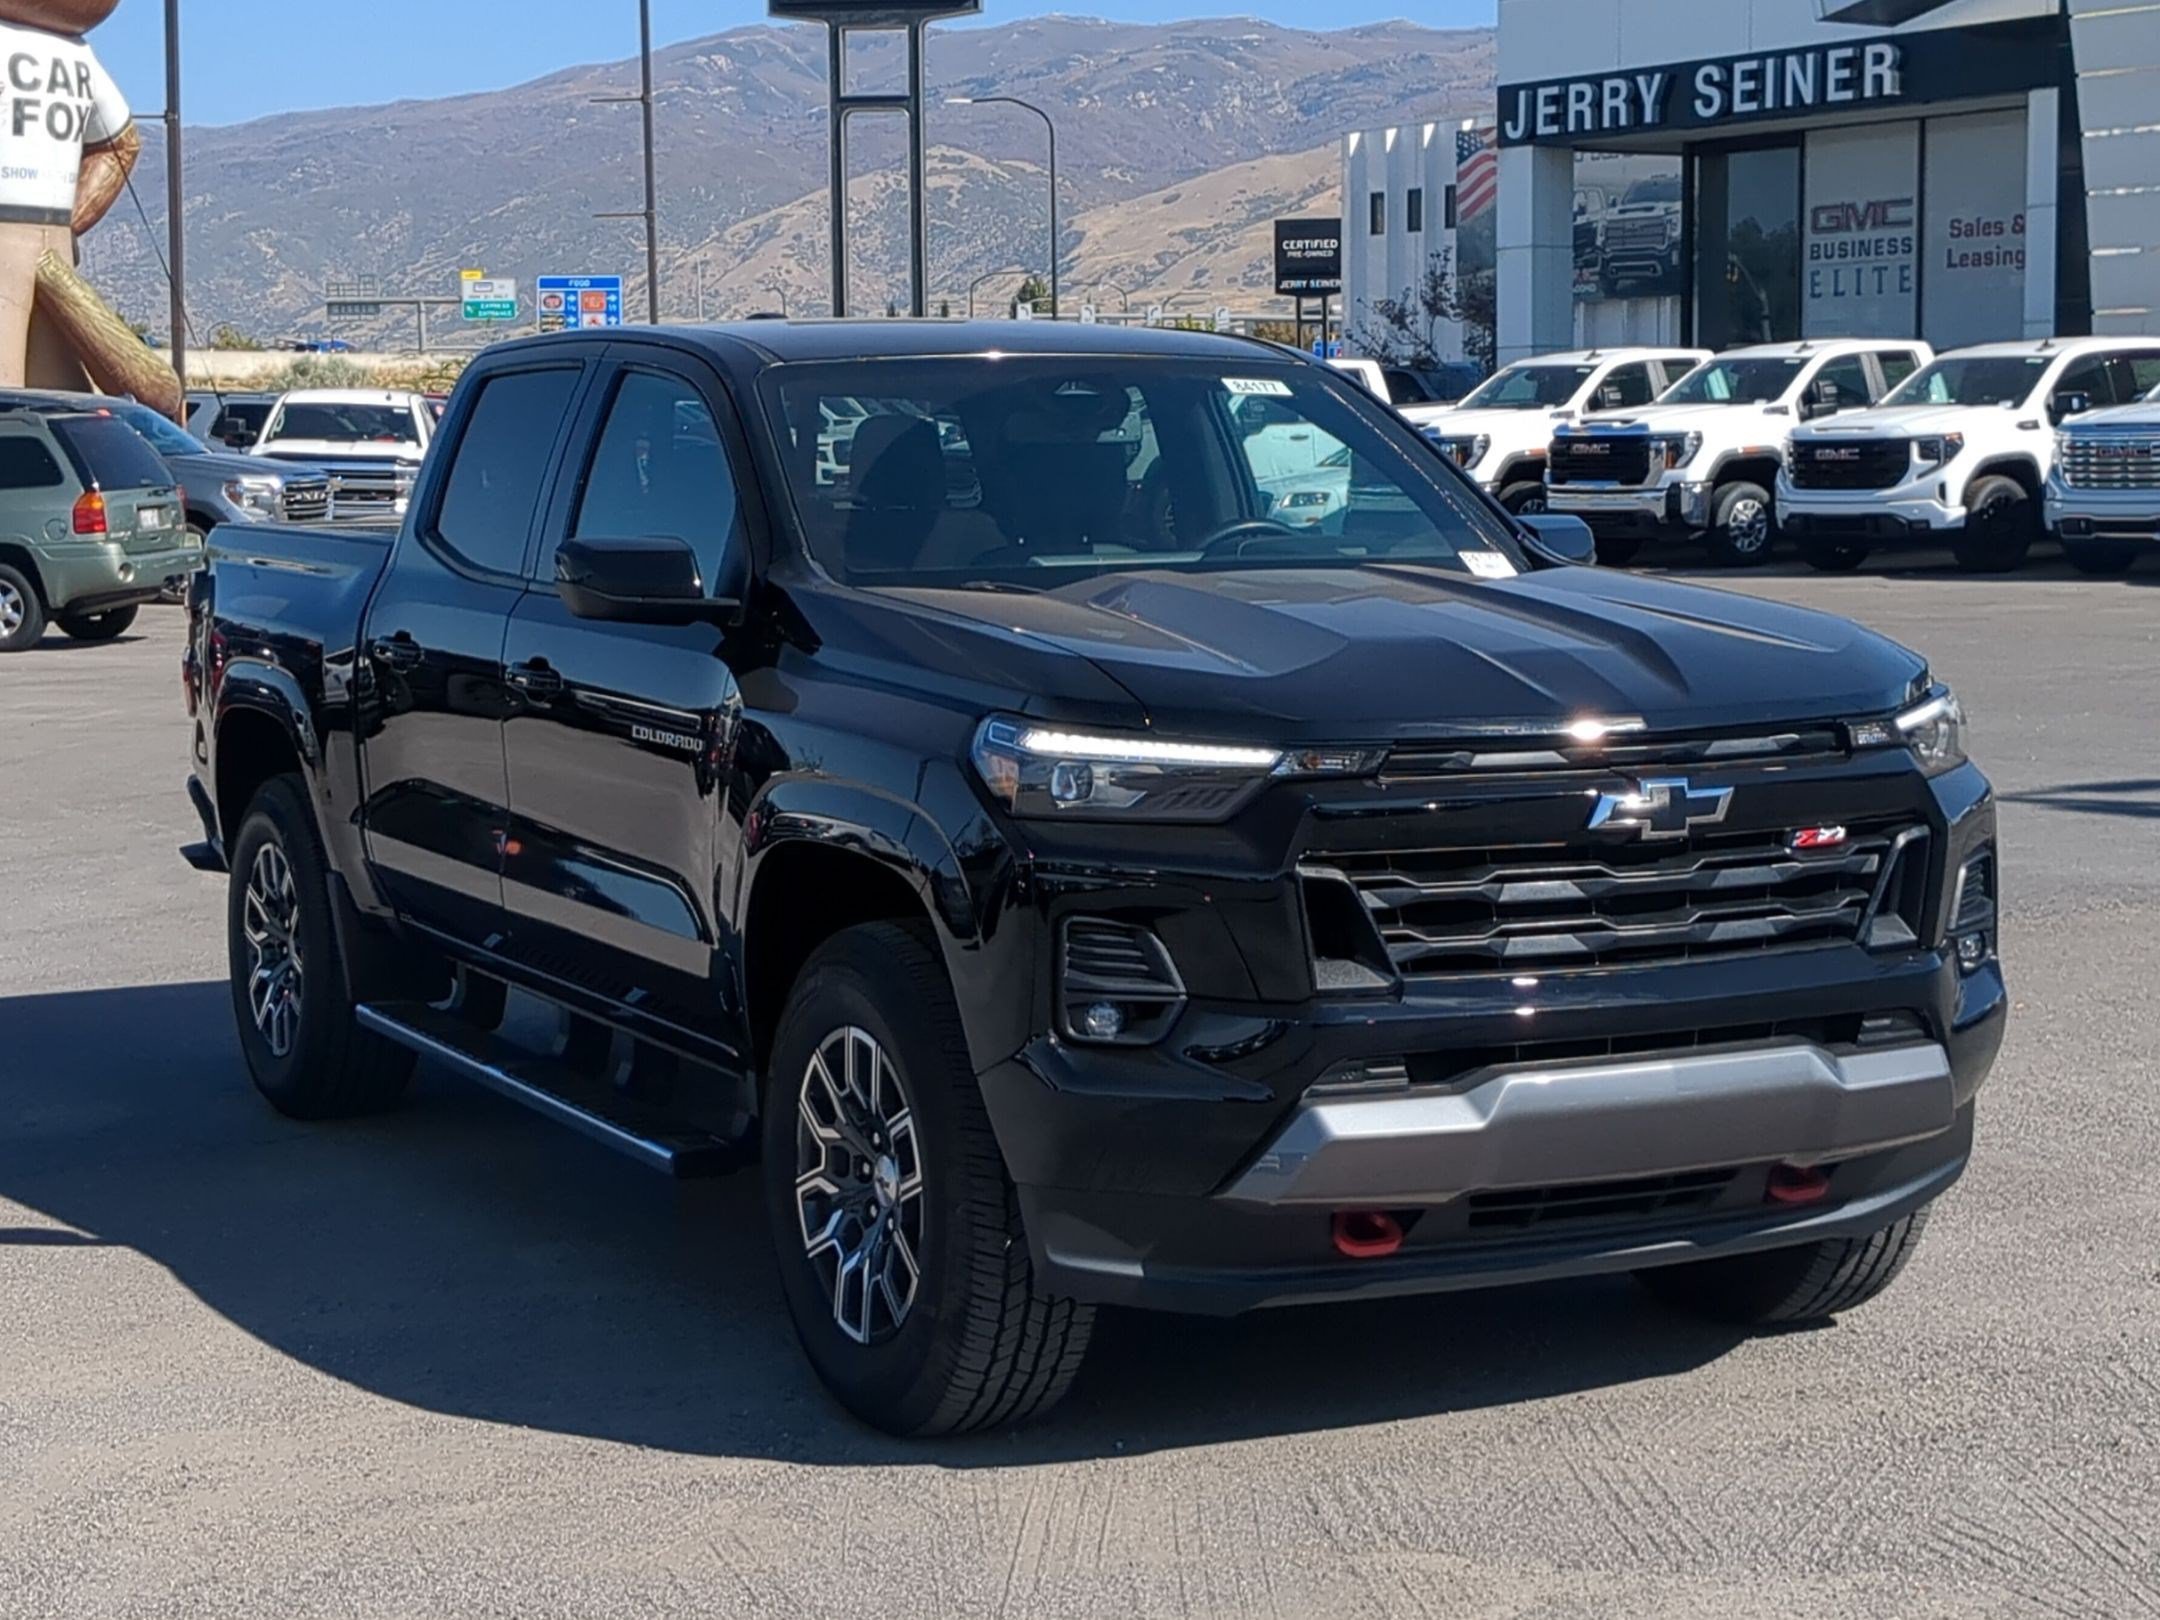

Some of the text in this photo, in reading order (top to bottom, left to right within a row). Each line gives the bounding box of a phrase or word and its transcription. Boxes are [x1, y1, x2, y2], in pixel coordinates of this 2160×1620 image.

[8, 52, 93, 100] CAR
[1505, 43, 1901, 140] JERRY SEINER
[12, 97, 90, 142] FOX
[1, 166, 39, 180] SHOW
[1811, 197, 1914, 235] GMC
[1949, 214, 2025, 239] Sales &
[1282, 239, 1339, 250] CERTIFIED
[1809, 236, 1913, 261] BUSINESS
[1946, 245, 2026, 270] Leasing
[1809, 264, 1913, 299] ELITE
[1233, 381, 1279, 393] 84177
[1571, 442, 1610, 454] GMC
[1815, 447, 1860, 461] GMC
[632, 724, 703, 752] COLORADO
